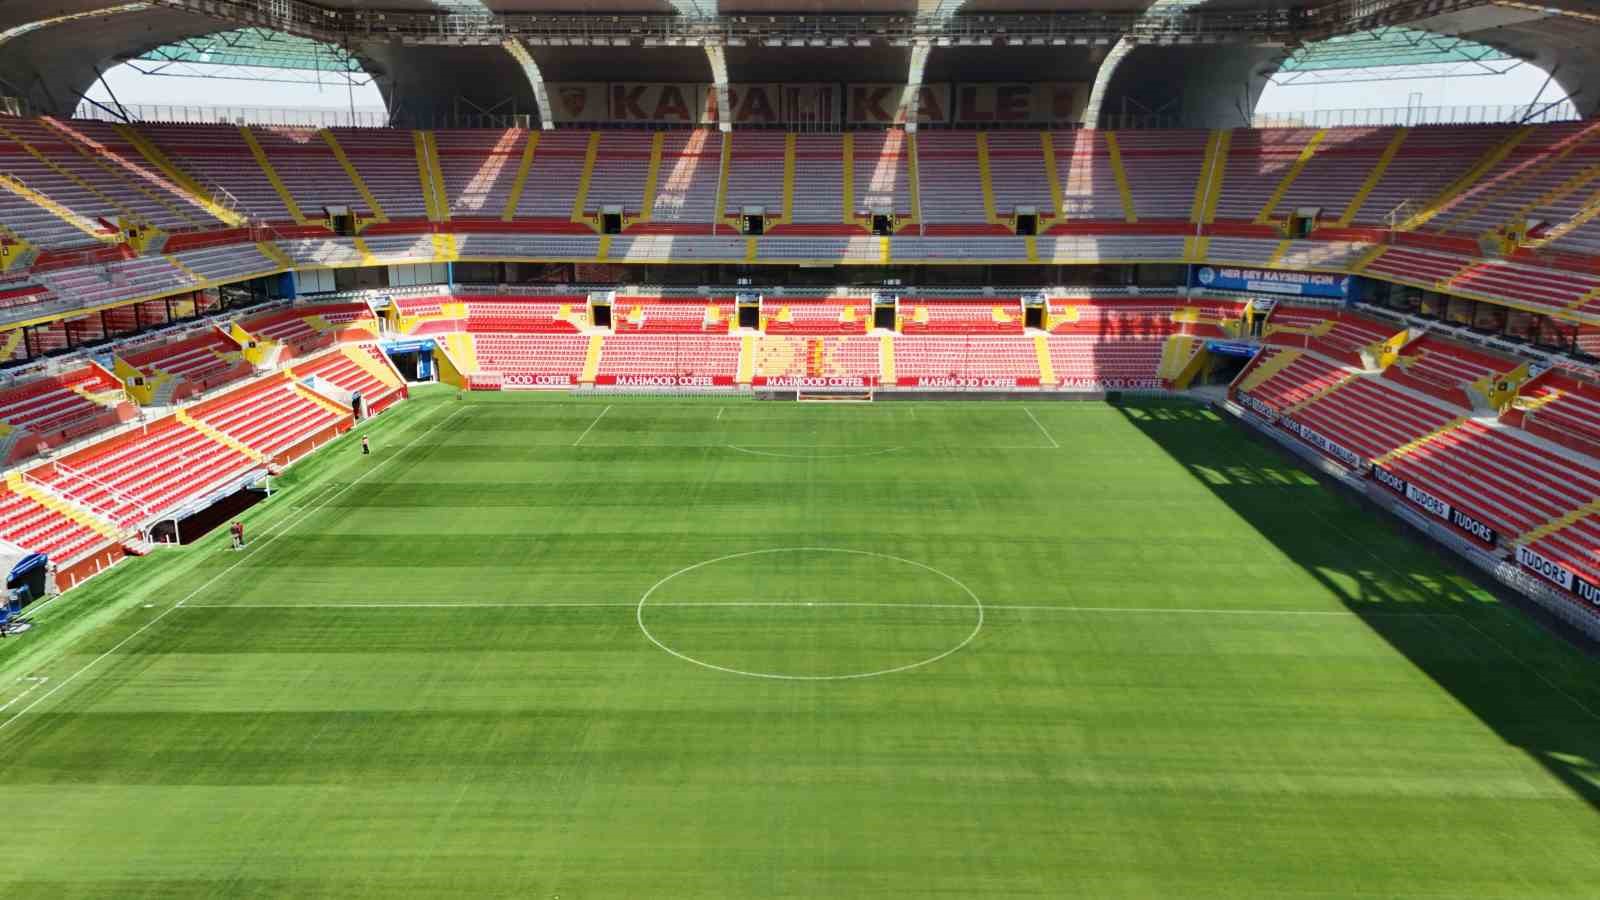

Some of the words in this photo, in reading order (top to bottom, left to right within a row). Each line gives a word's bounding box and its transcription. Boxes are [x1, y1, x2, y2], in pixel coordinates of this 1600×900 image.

[852, 86, 1031, 121] KALE
[616, 376, 675, 386] MAHMOOD
[678, 376, 713, 386] COFFEE
[766, 377, 827, 387] MAHMOOD
[829, 377, 864, 387] COFFEE
[918, 377, 979, 387] MAHMOOD
[982, 377, 1017, 387] COFFEE
[1375, 467, 1404, 491] TUDORS
[1411, 487, 1445, 515] TUDORS
[1453, 510, 1491, 542] TUDORS
[1521, 548, 1566, 584] TUDORS
